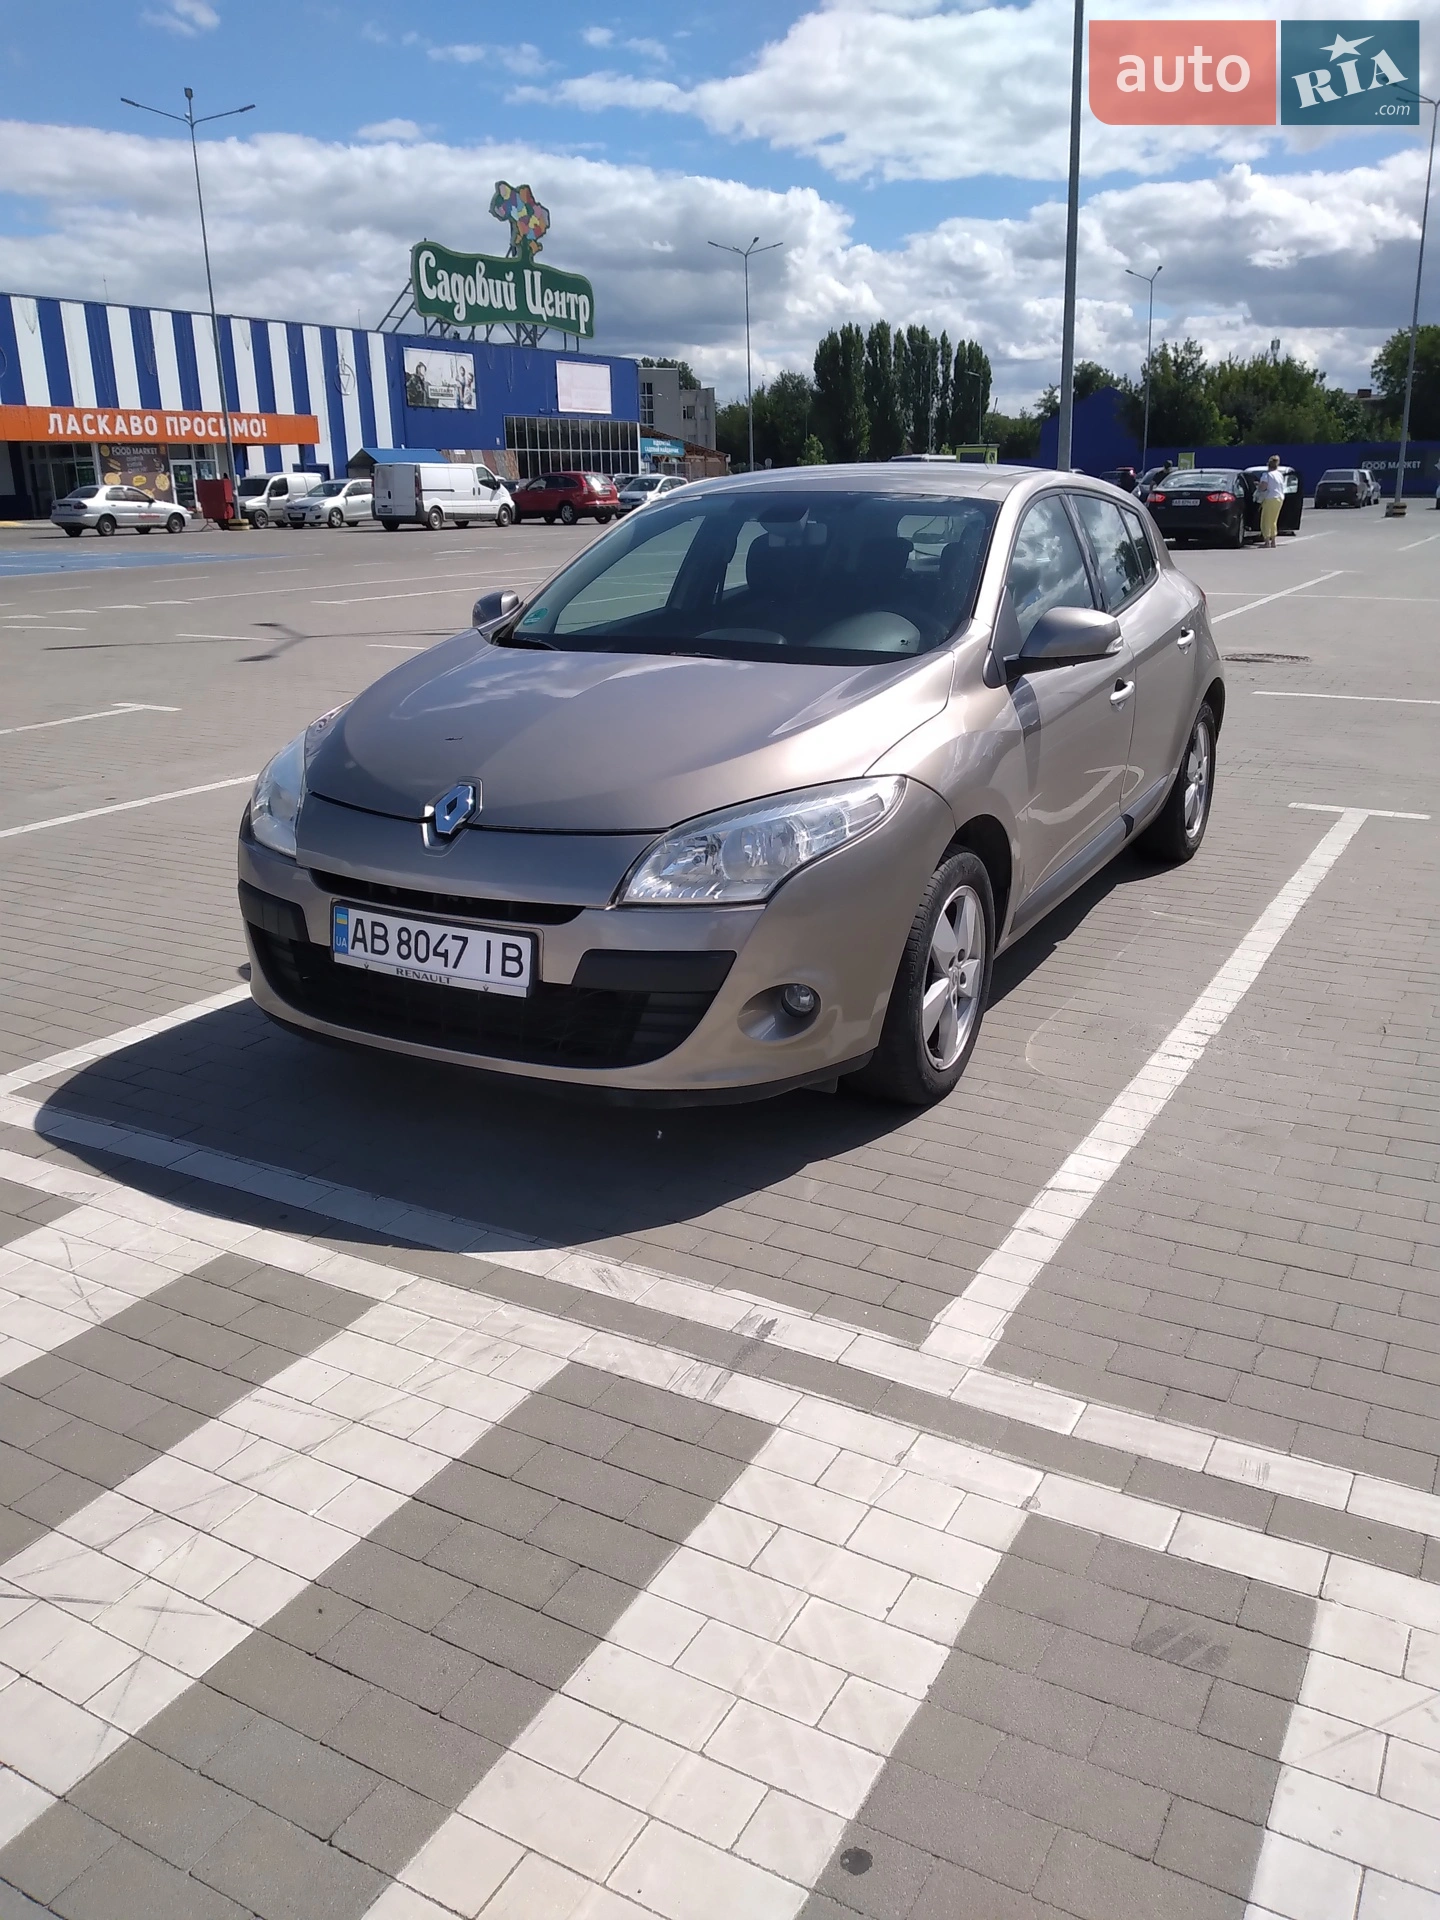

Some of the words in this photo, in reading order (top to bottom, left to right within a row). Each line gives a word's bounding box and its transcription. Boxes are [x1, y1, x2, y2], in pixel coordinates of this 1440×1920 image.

[419, 251, 517, 321] Садовий
[523, 269, 590, 334] Центр
[48, 413, 157, 436] ЛАСКАВО
[166, 417, 268, 438] ПРОСИМО!
[111, 446, 131, 455] FOOD
[132, 447, 158, 455] MARKET
[1361, 460, 1387, 470] FOOD
[336, 937, 348, 949] UA
[351, 918, 389, 955] AB
[396, 927, 469, 969] 8047
[486, 940, 524, 978] IB
[396, 967, 452, 985] RENAULT
